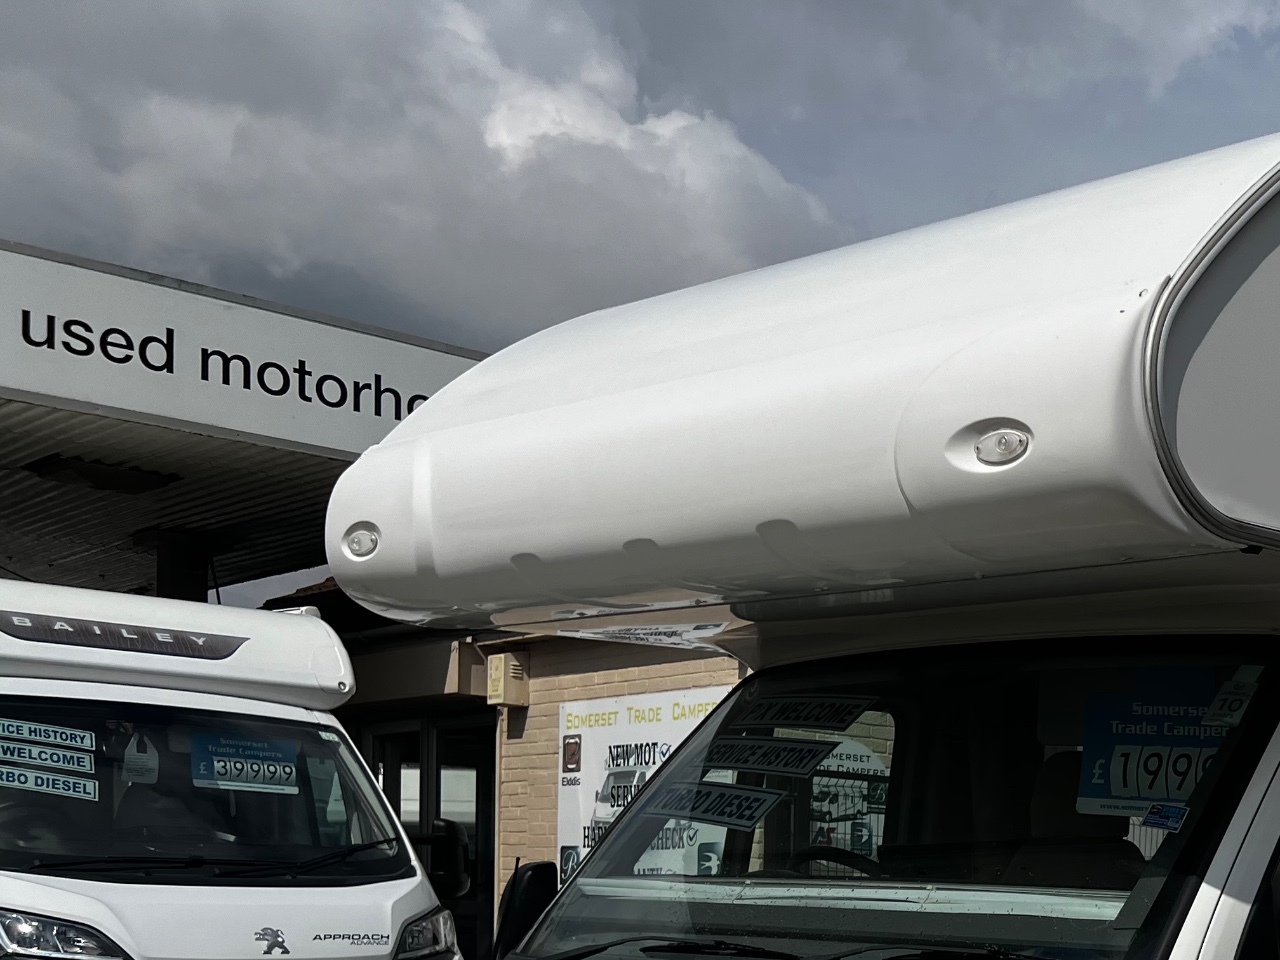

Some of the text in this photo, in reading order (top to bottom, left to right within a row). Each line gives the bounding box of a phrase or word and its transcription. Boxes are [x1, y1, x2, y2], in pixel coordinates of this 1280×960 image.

[21, 309, 175, 374] used
[11, 616, 207, 646] BAILEY
[770, 702, 861, 724] WELCOME
[1131, 702, 1208, 717] Somerse
[1218, 697, 1243, 713] 10
[566, 710, 619, 730] SOMERSET
[627, 706, 662, 724] TRADE
[28, 726, 86, 744] HISTORY
[1109, 720, 1230, 740] Trade Camper
[1, 744, 86, 768] WELCOME
[608, 742, 658, 768] NEW MOT
[705, 744, 824, 769] SERVICE HISTORY
[216, 759, 293, 781] 39999
[1091, 759, 1106, 784] £
[34, 775, 91, 795] DIESEL
[702, 791, 767, 821] DIESEL
[312, 933, 390, 941] APPROACH
